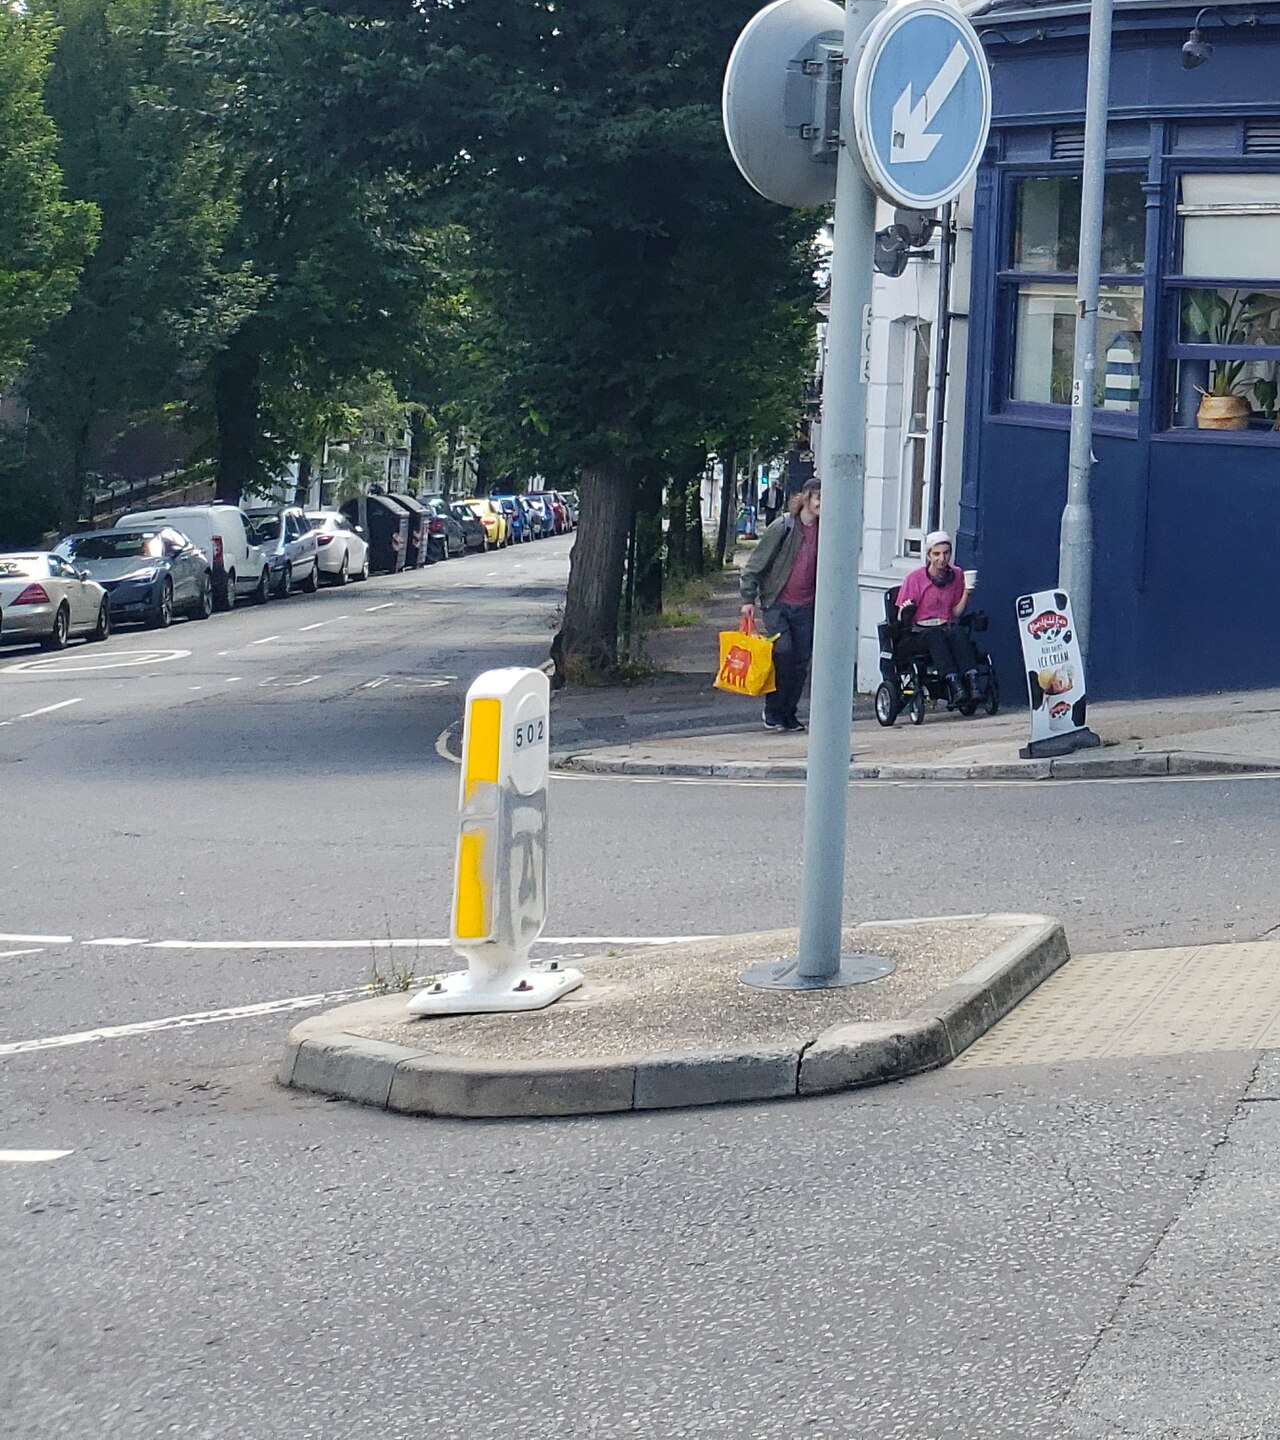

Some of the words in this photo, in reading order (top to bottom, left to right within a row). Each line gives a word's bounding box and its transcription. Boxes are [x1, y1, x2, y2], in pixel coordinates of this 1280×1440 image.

[1037, 655, 1049, 669] ICE
[1049, 651, 1070, 666] CREAM
[516, 720, 543, 748] 502
